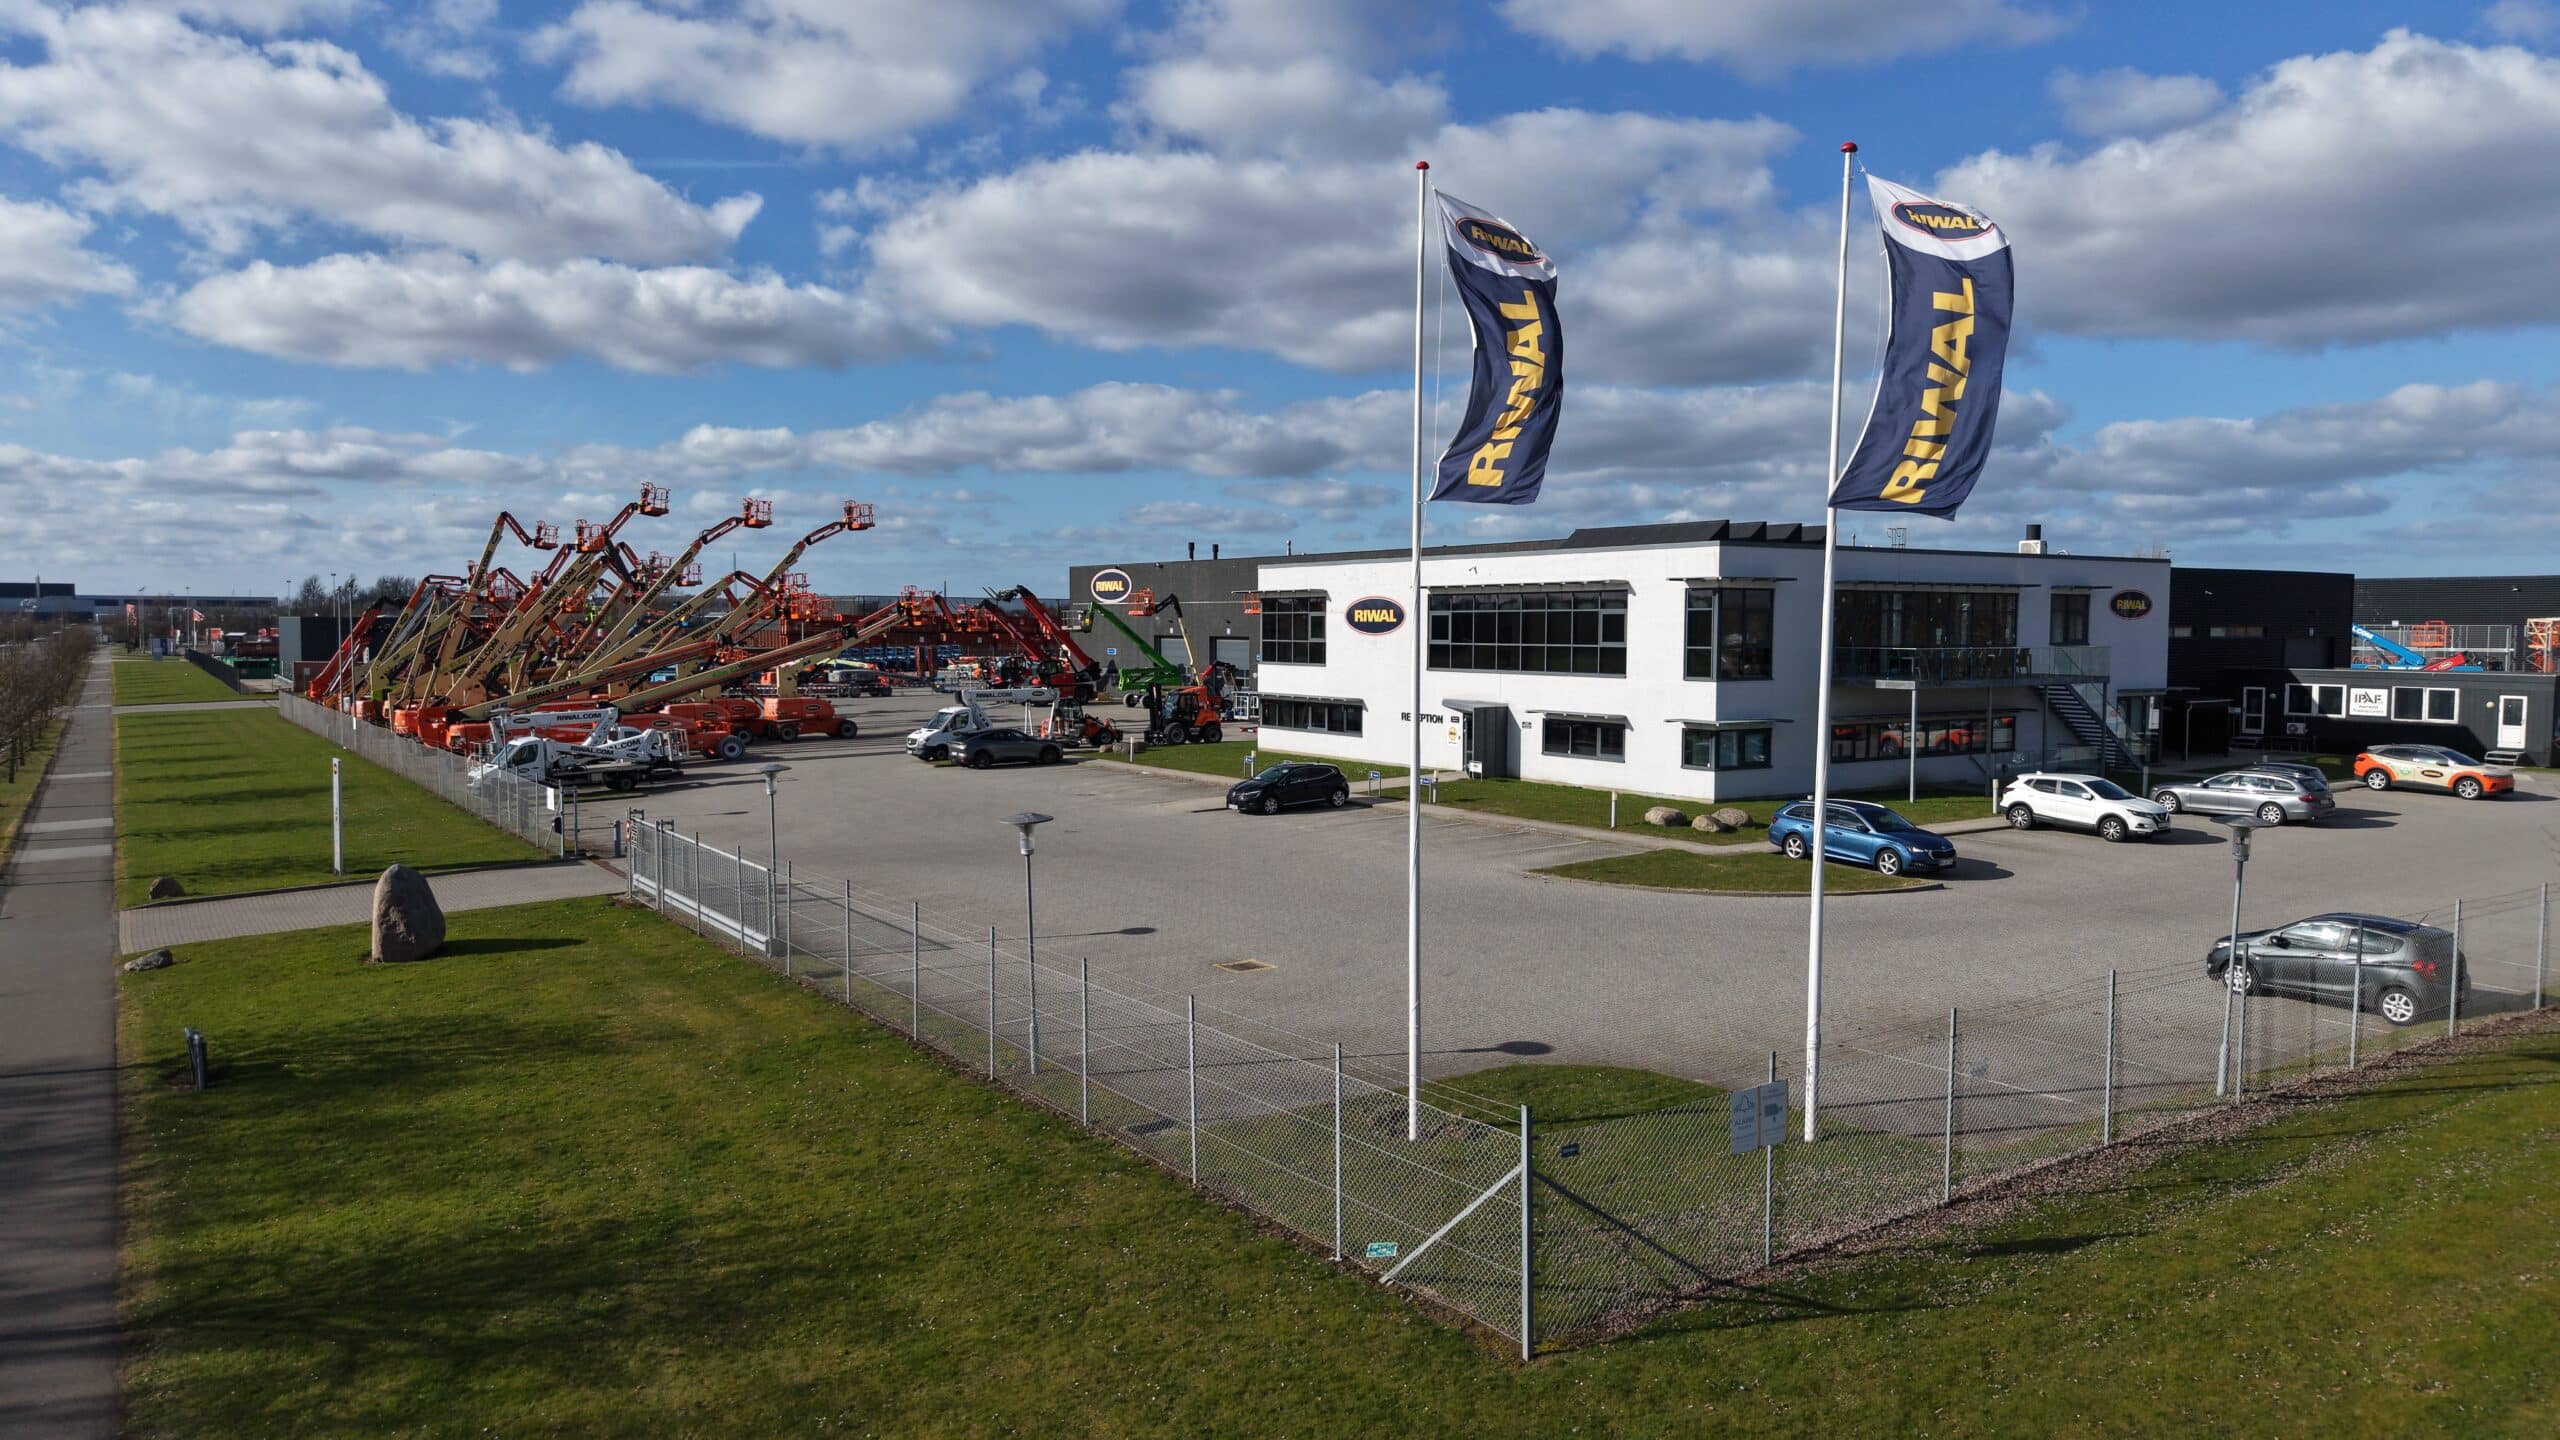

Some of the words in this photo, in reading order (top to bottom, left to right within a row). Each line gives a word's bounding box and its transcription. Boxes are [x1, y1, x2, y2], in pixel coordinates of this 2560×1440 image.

[1904, 207, 1979, 230] RIWAL
[1471, 225, 1534, 256] RIWAL
[1467, 290, 1546, 487] RIWAL
[1879, 277, 1976, 505] RIWAL
[1095, 580, 1125, 592] RIWAL
[2116, 599, 2148, 610] RIWAL
[1354, 609, 1397, 622] RIWAL
[2354, 691, 2382, 704] IPAF
[1401, 712, 1444, 724] REEPTION
